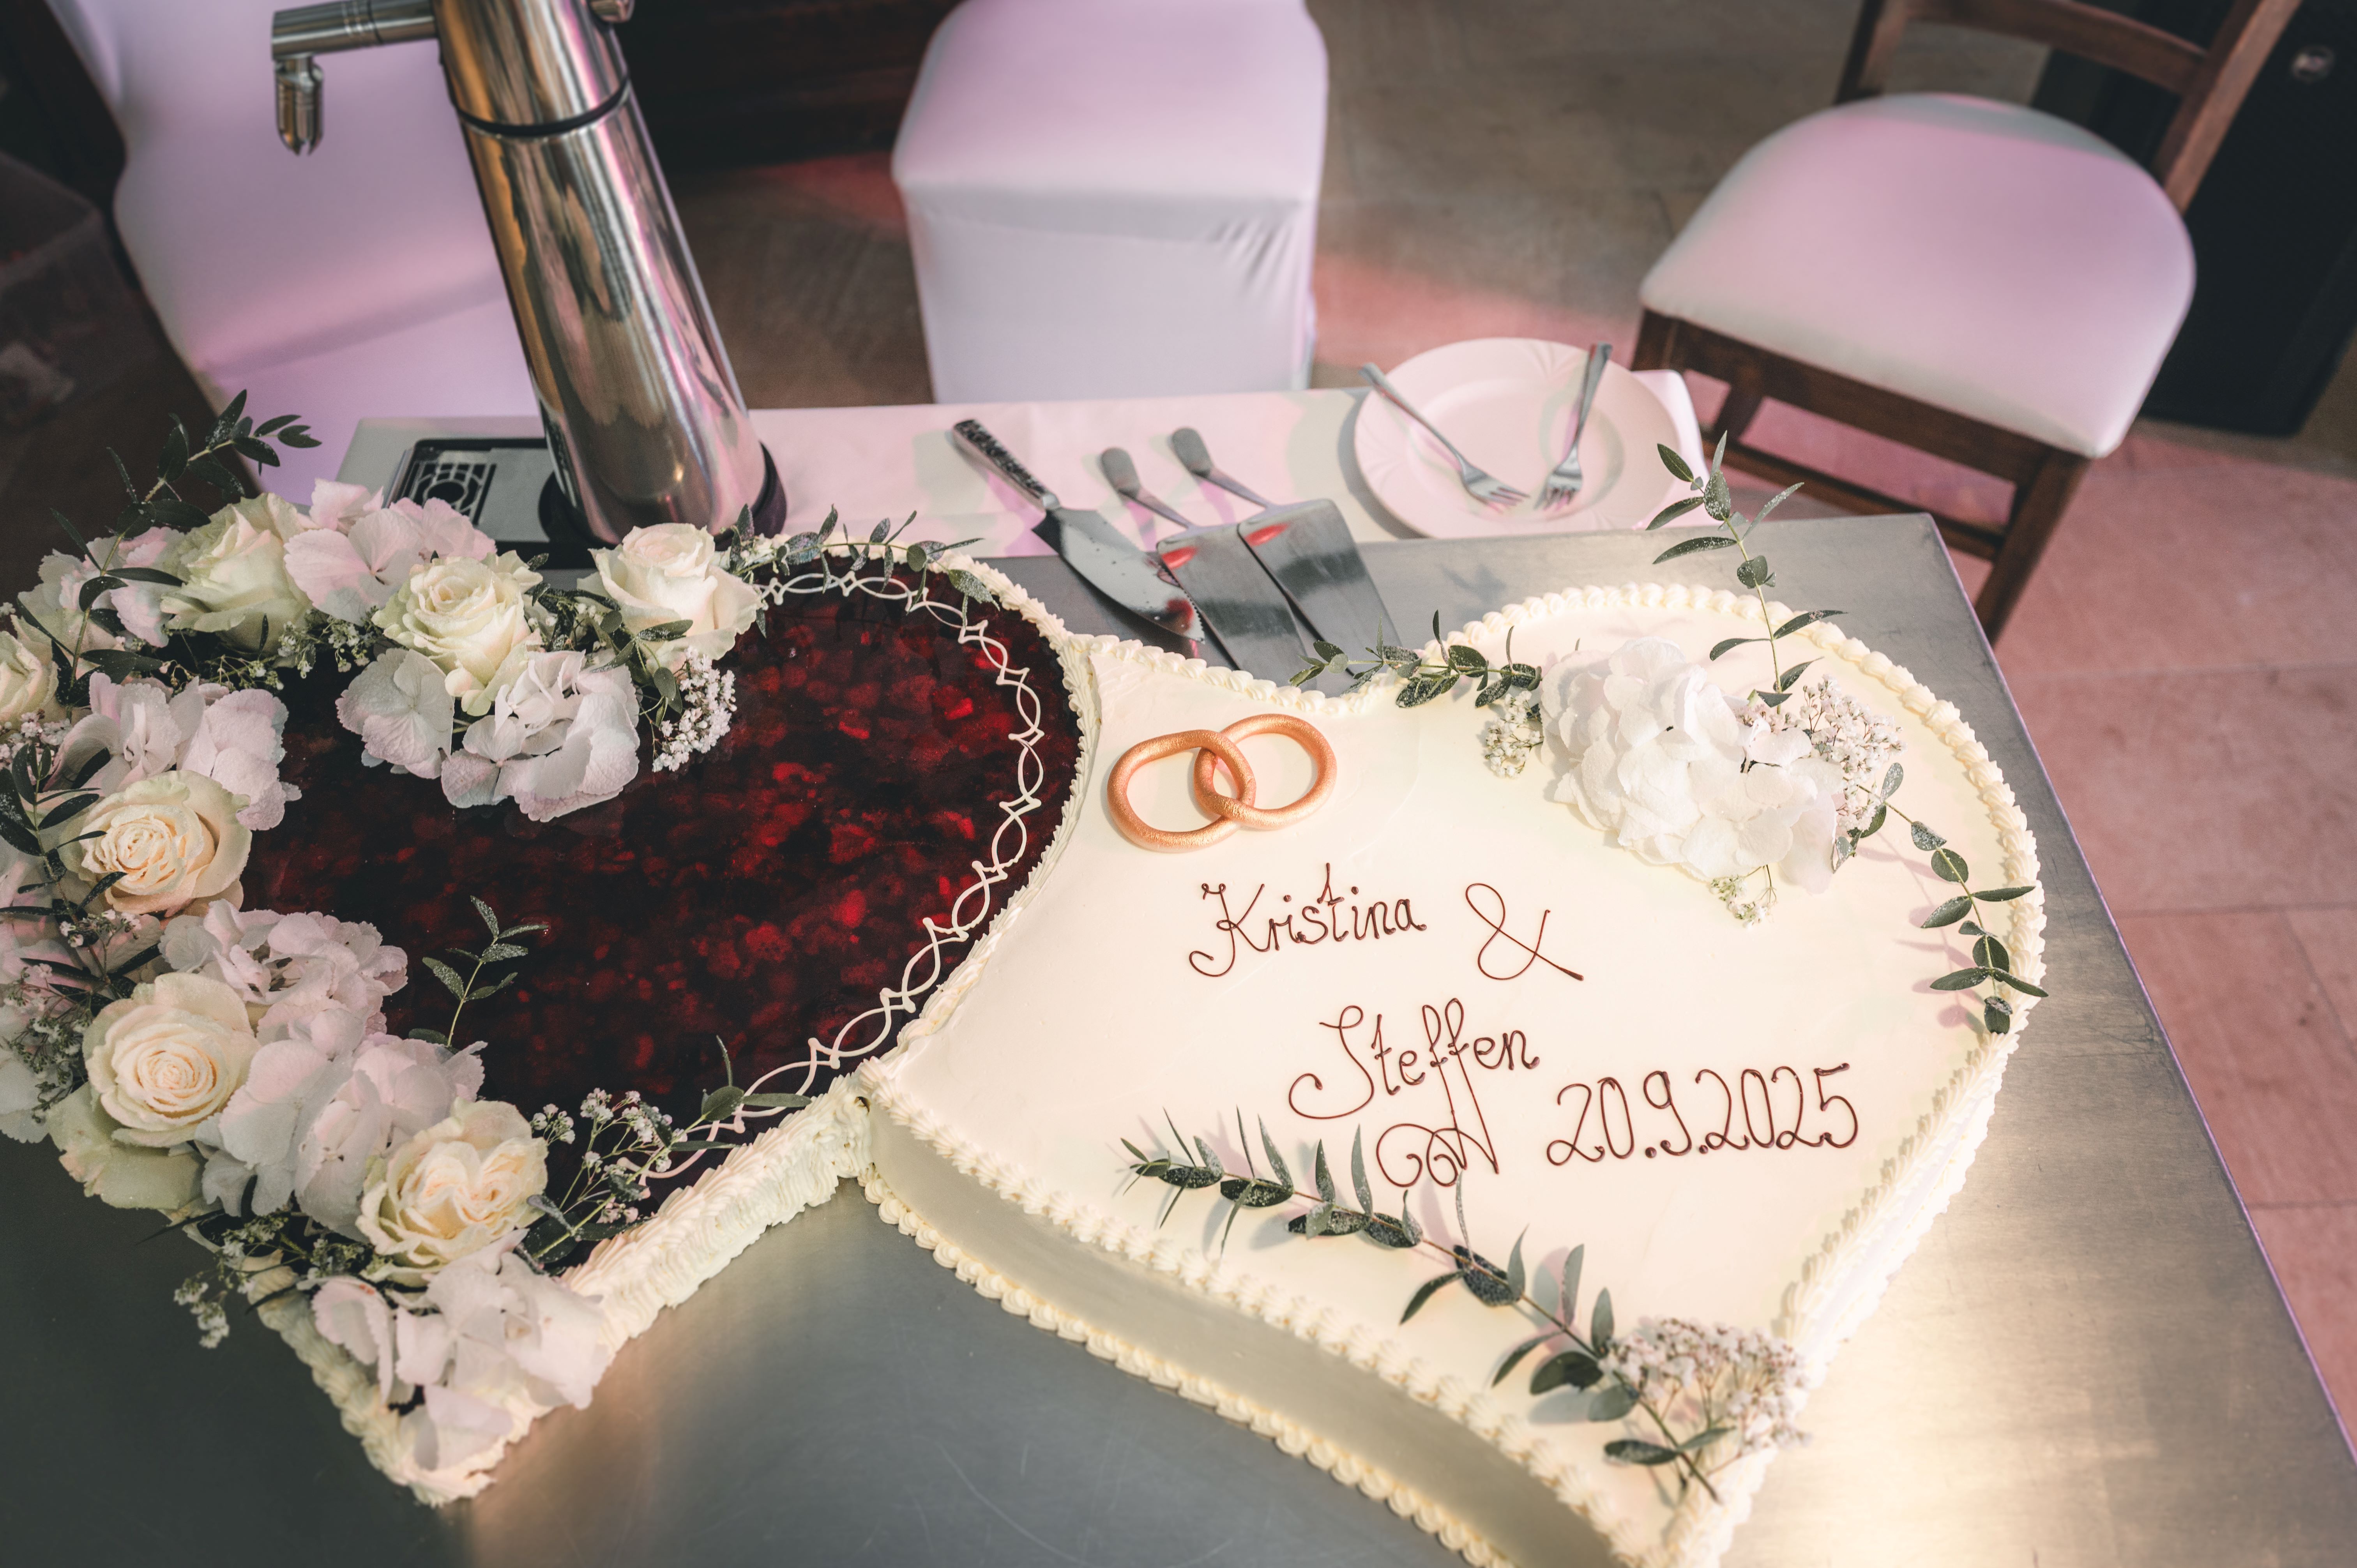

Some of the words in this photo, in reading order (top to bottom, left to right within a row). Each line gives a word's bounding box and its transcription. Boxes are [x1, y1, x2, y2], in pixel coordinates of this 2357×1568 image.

[1189, 863, 1427, 977] Kristina
[1465, 883, 1584, 981] &
[1288, 998, 1540, 1187] Steffen
[1546, 1063, 1858, 1166] 20.9.2025
